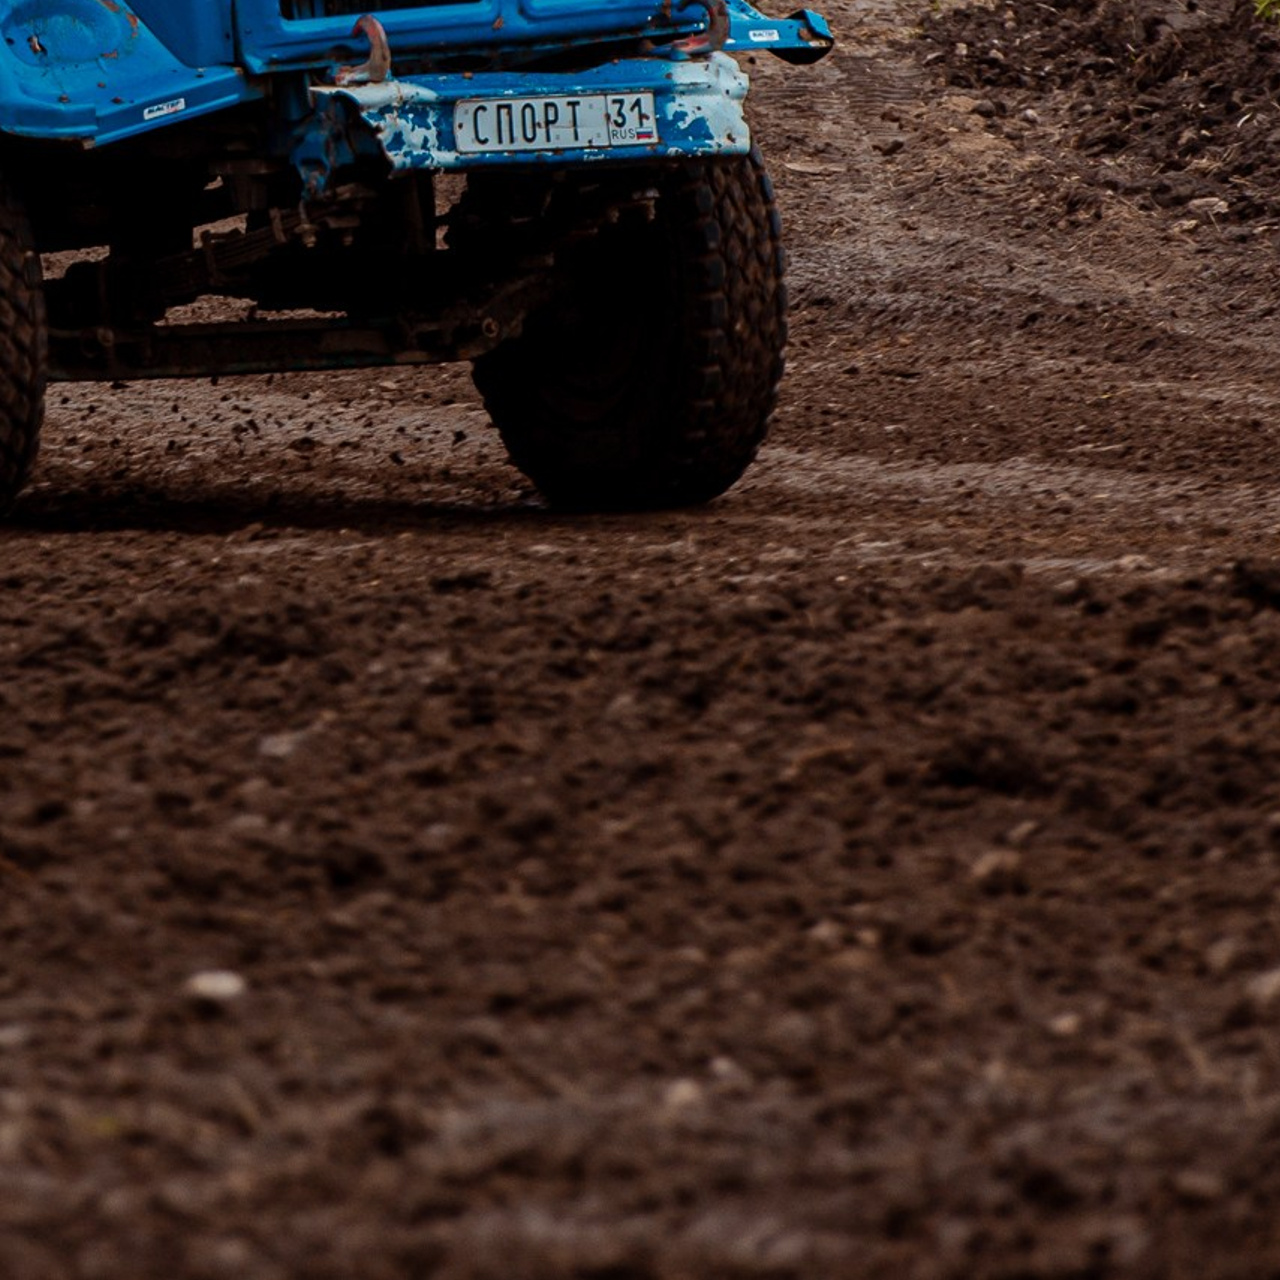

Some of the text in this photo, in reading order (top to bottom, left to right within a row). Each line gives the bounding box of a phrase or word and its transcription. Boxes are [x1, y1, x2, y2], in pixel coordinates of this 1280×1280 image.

[473, 100, 580, 145] СПОРТ
[612, 97, 646, 128] 31
[612, 128, 636, 139] RUS
